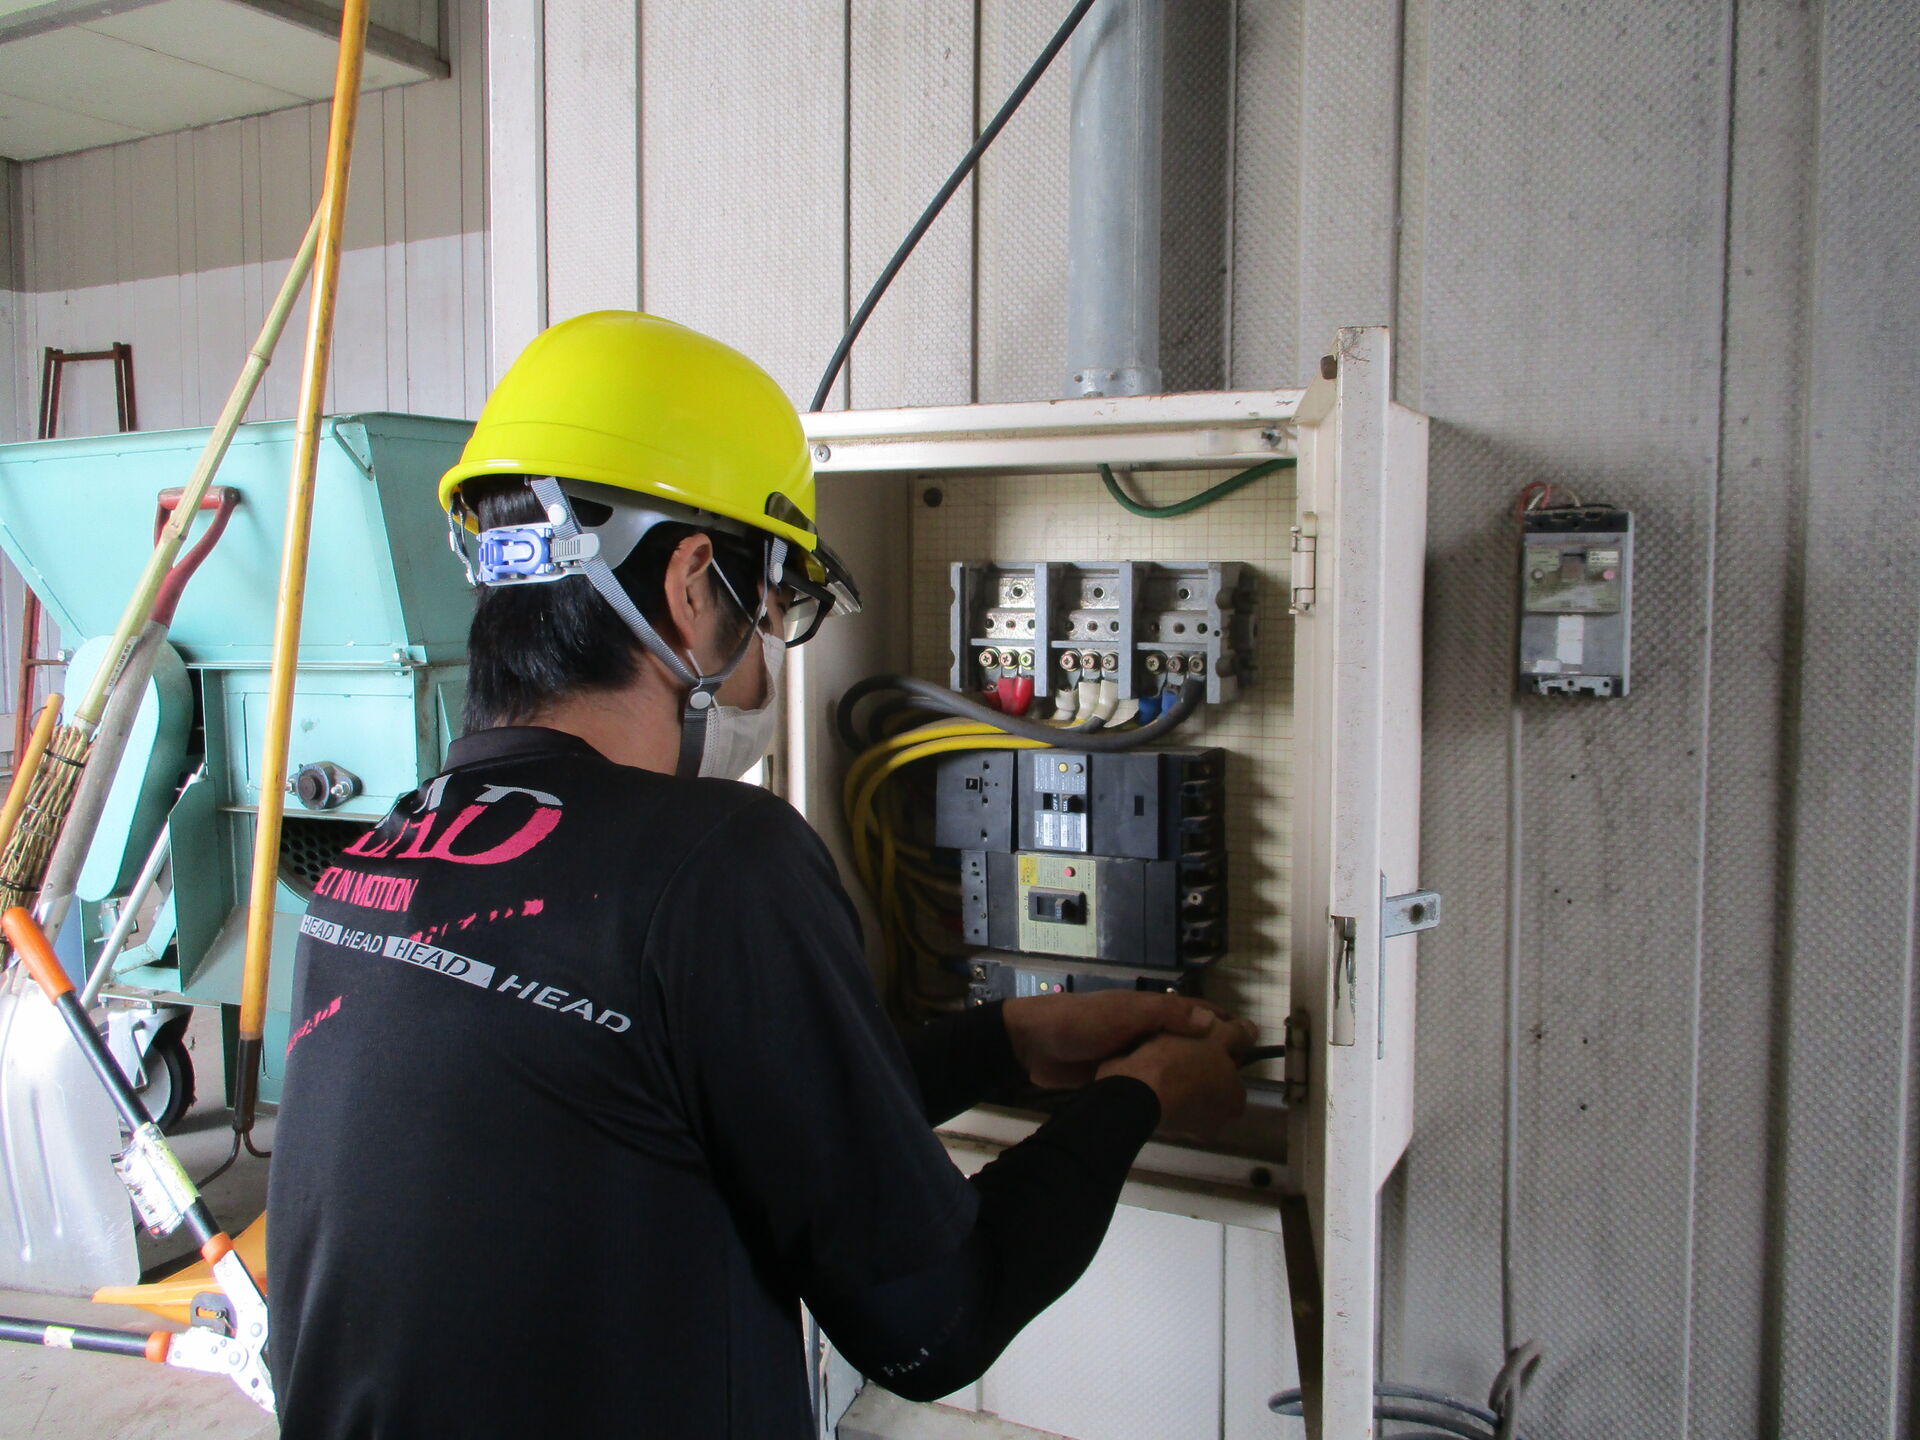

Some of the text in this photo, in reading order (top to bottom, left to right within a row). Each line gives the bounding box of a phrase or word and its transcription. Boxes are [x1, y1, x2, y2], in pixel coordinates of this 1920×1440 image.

[350, 872, 419, 912] MOTION
[303, 915, 631, 1033] HEAD HEAD HEAD HEAD
